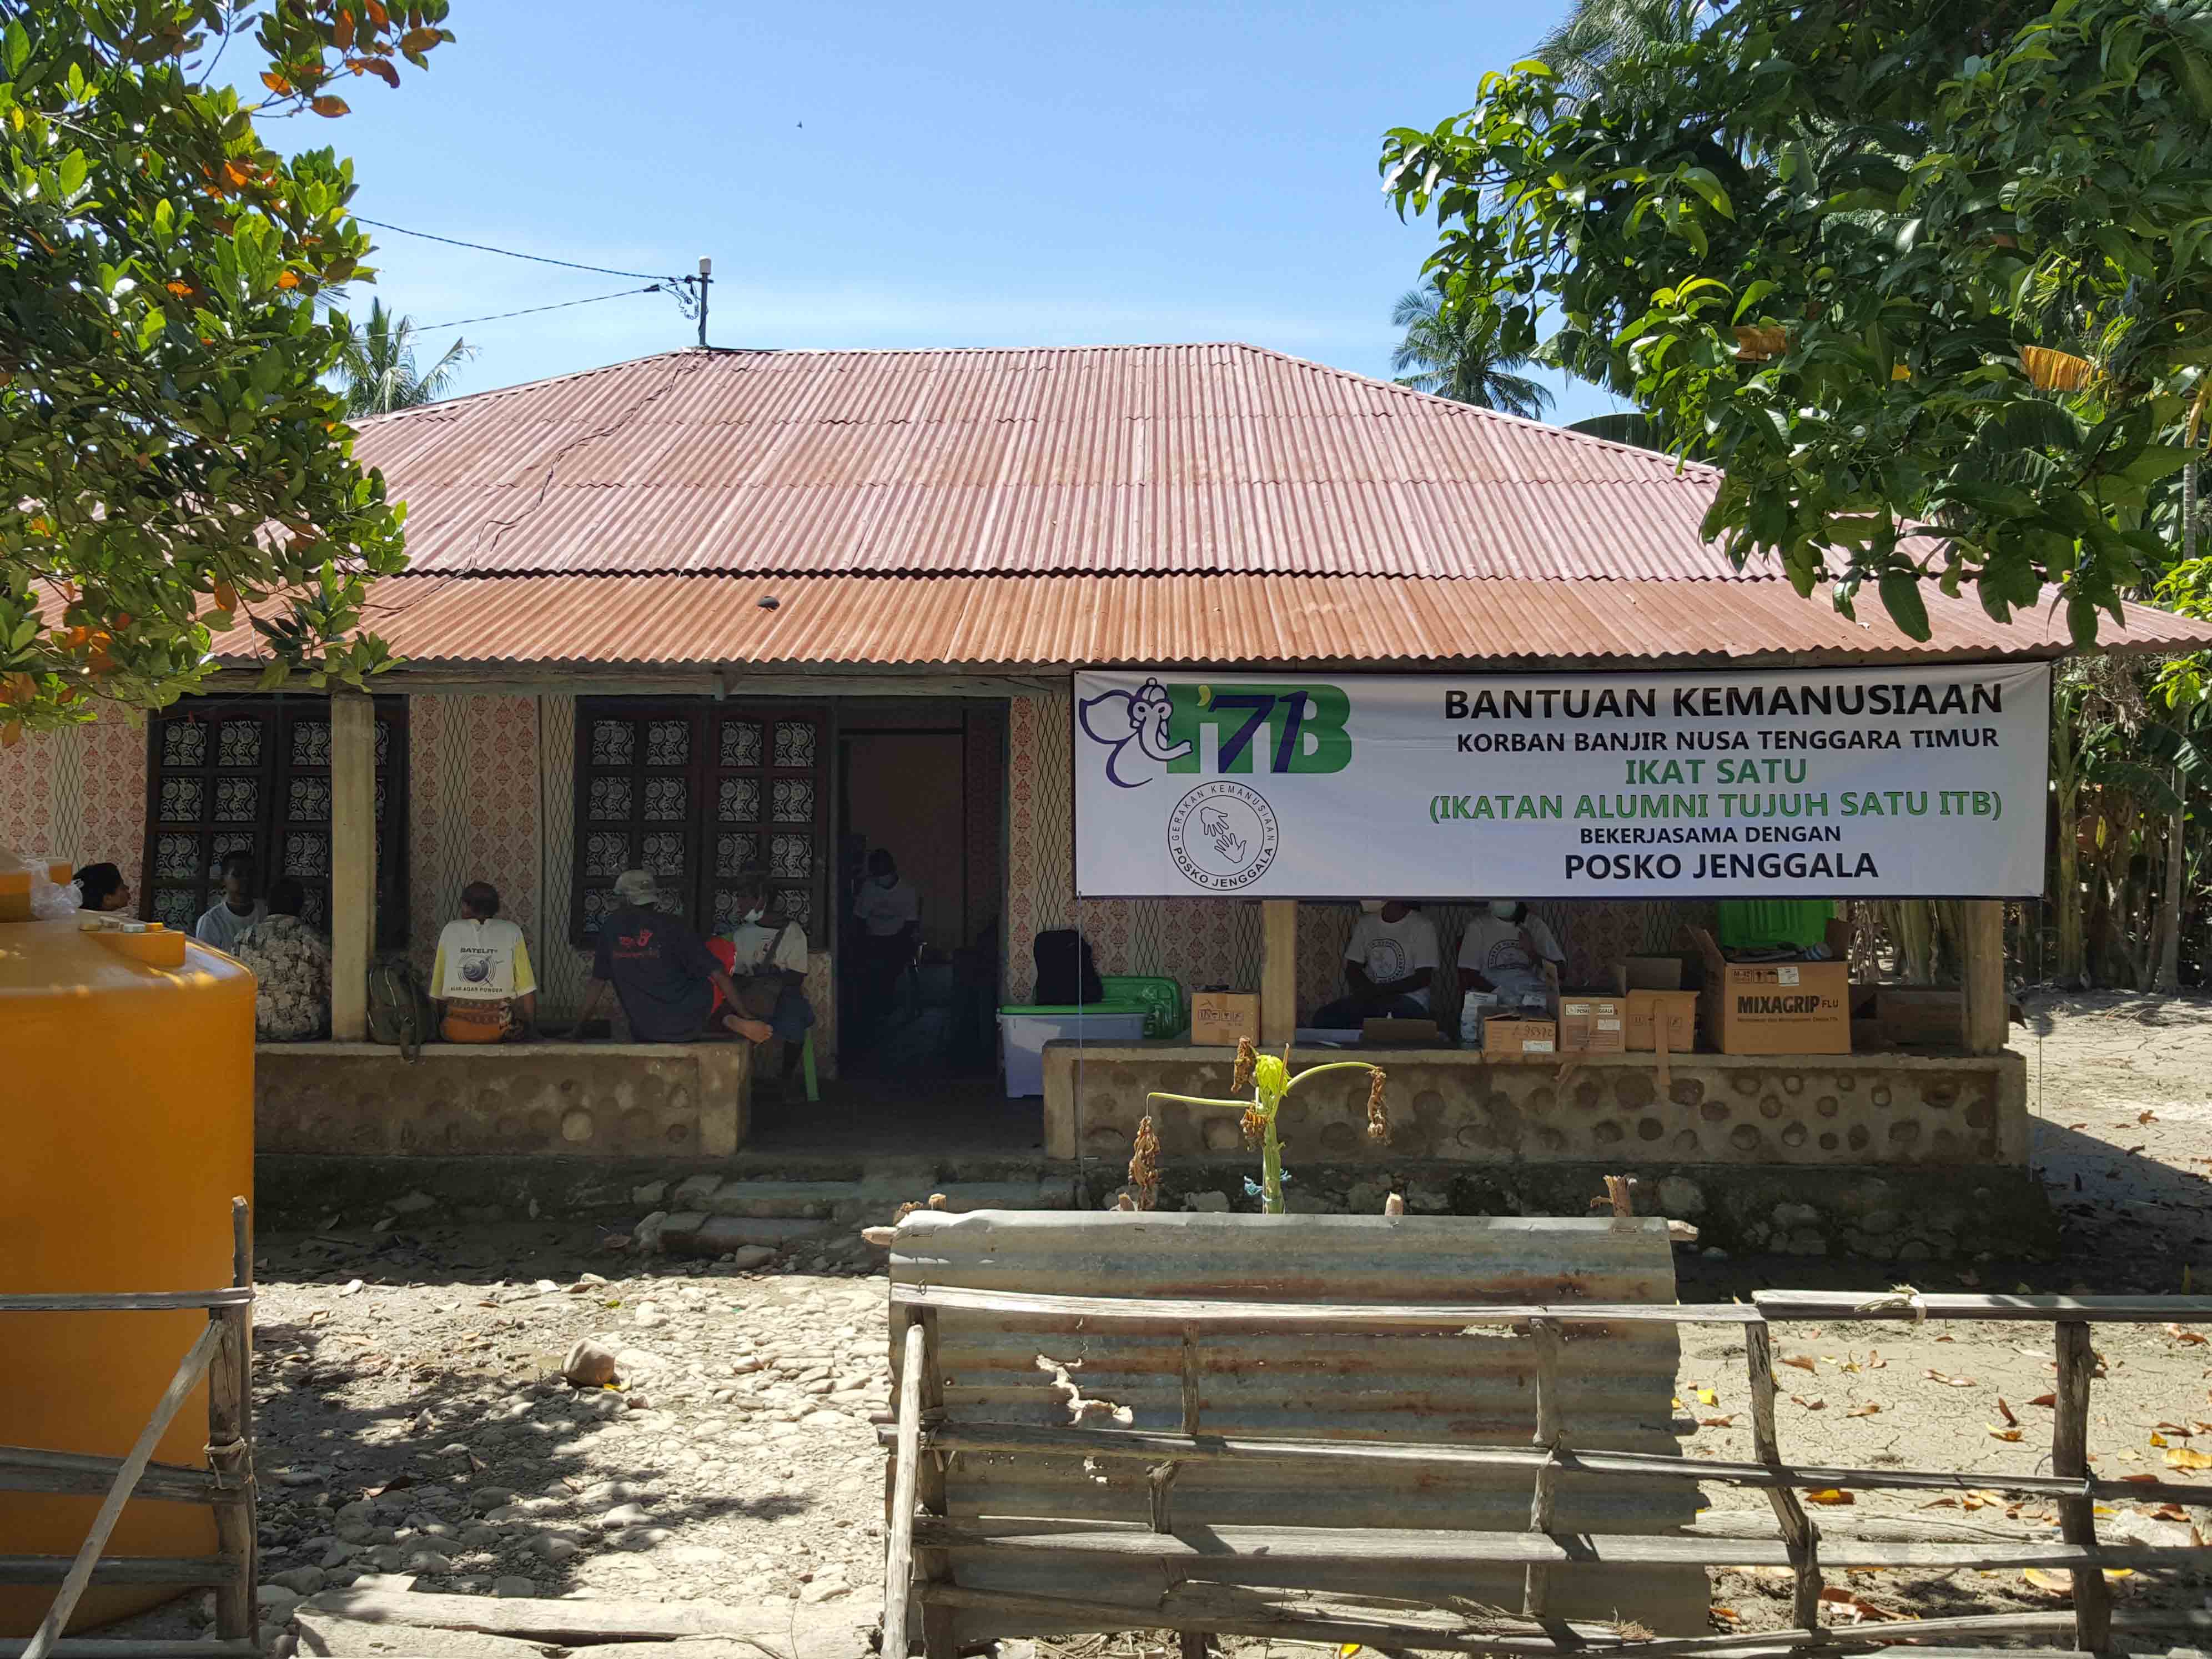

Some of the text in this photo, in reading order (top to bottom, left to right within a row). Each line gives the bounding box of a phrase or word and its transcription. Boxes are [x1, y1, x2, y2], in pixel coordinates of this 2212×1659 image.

[1445, 683, 2002, 719] BANTUAN KEMANUSIAAN
[1457, 728, 1999, 752] KORBAN BANJIR NUSA TENGGARA TIMUR
[1625, 758, 1807, 784] IKAT SATU
[1172, 785, 1275, 841] GERAKAN KEMANUSIAAN
[1430, 791, 2002, 821] (IKATAN ALUMNI TUJUH SATU ITB)
[1581, 826, 1841, 844] BEKERJASAMA DENGAN
[1173, 847, 1274, 887] POSKO JENGGALA
[1565, 852, 1879, 879] POSKO JENGGALA
[1737, 995, 1839, 1013] MIXAGRIP FLU
